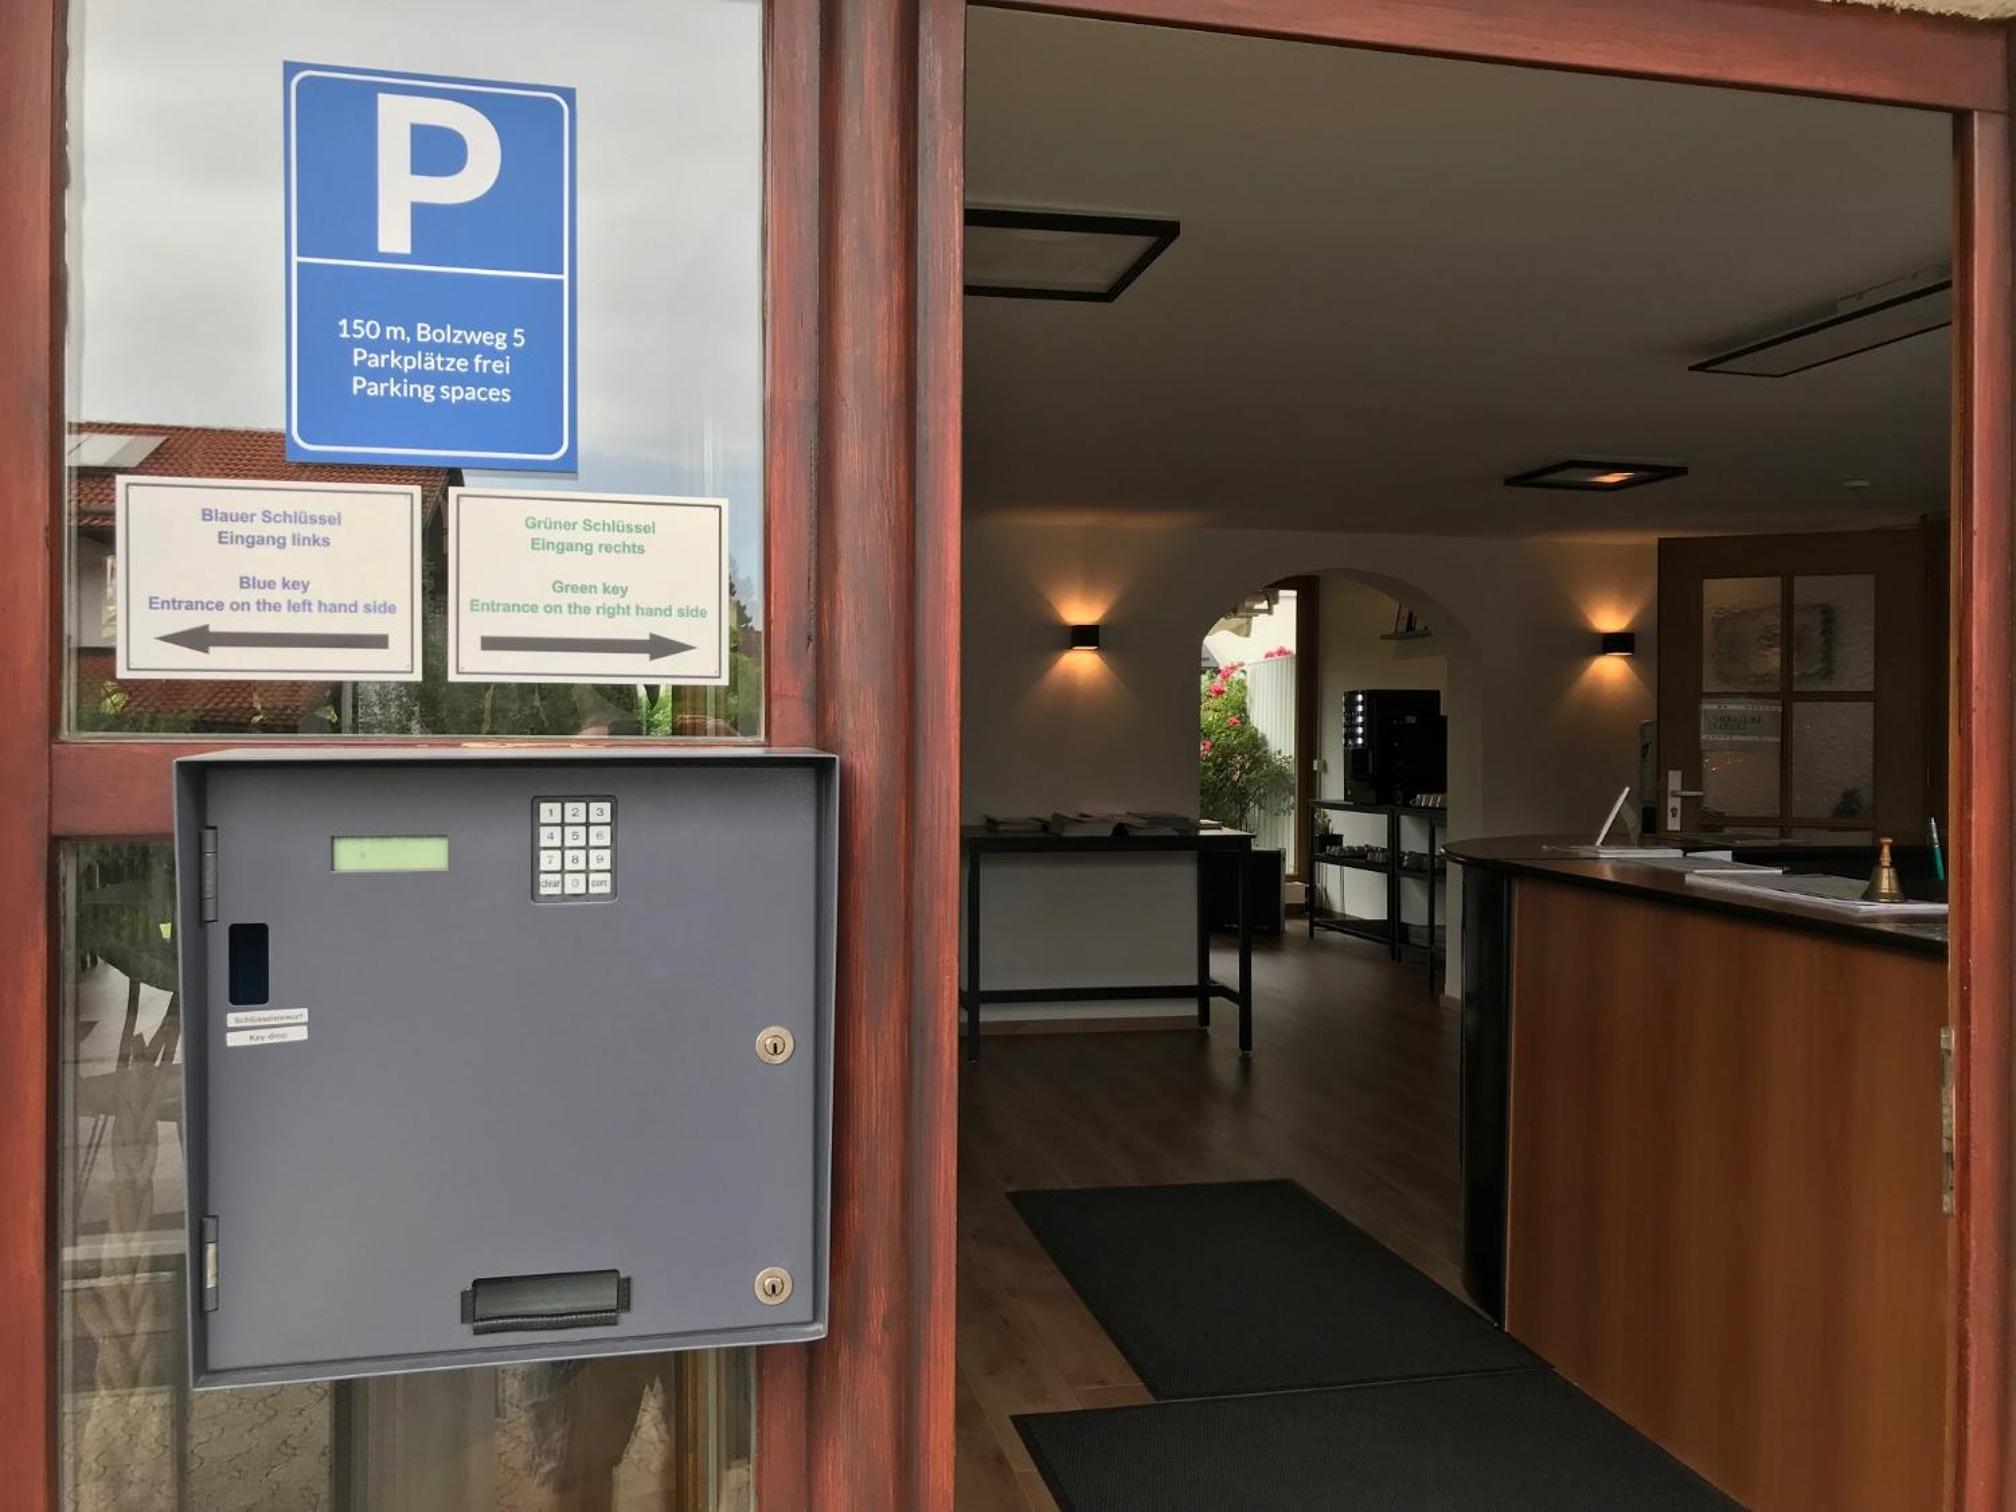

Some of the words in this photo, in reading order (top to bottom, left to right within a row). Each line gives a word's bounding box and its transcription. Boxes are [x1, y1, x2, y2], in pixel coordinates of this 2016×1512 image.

[377, 93, 501, 254] P
[338, 319, 381, 339] 150
[386, 323, 410, 344] m,
[417, 323, 507, 350] Bolzweg
[513, 329, 525, 347] 5
[353, 348, 468, 372] Parkplätze
[474, 353, 511, 374] frei
[353, 377, 435, 402] Parking
[440, 384, 511, 403] spaces
[201, 509, 256, 523] Blauer
[261, 510, 341, 526] Schlüssel
[524, 516, 578, 531] Grüner
[582, 519, 656, 534] Schlüssel
[218, 531, 286, 549] Eingang
[292, 533, 330, 547] links
[530, 538, 594, 556] Eingang
[598, 541, 645, 554] rechts
[239, 576, 276, 590] Blue
[282, 577, 310, 594] key
[552, 581, 597, 594] Green
[603, 582, 628, 598] key
[149, 597, 224, 611] Entrance
[230, 601, 250, 612] on
[256, 600, 282, 612] the
[287, 600, 313, 613] left
[318, 601, 357, 614] hand
[363, 602, 396, 614] side
[470, 600, 538, 613] Entrance
[544, 604, 560, 614] on
[568, 602, 591, 615] the
[596, 603, 630, 618] right
[636, 604, 672, 617] hand
[677, 604, 708, 618] side
[549, 809, 553, 817] 1
[572, 808, 580, 817] 2
[596, 808, 604, 816] 3
[547, 832, 554, 840] 4
[572, 832, 579, 840] 5
[596, 831, 603, 839] 6
[547, 855, 554, 864] 7
[571, 856, 579, 864] 8
[596, 855, 604, 863] 9
